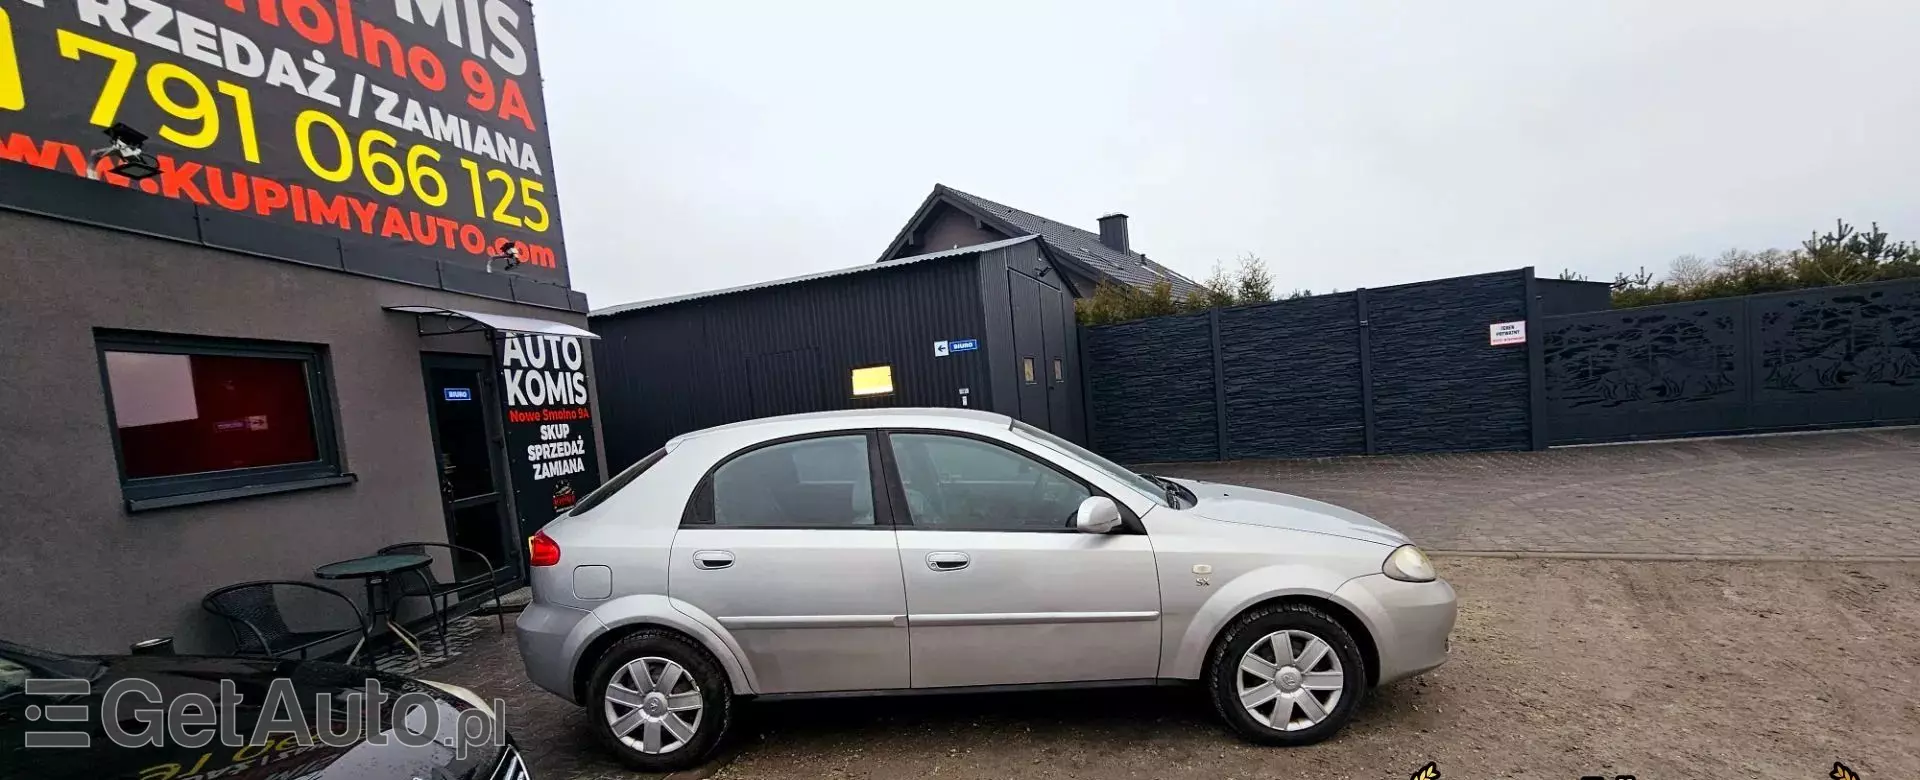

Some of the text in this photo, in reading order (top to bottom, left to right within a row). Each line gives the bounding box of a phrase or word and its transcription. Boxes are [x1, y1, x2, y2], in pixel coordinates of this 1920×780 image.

[24, 0, 341, 108] RZEDAŻ
[371, 83, 542, 176] ZAMIANA
[461, 59, 536, 132] 9A
[56, 28, 549, 232] 791 066 125
[503, 332, 582, 371] AUTO
[504, 369, 587, 406] KOMIS
[509, 410, 541, 423] Nowe
[542, 408, 577, 421] Smolno
[540, 424, 570, 440] SKUP
[527, 435, 586, 461] SPRZEDAŻ
[532, 457, 586, 480] ZAMIANA
[1195, 578, 1210, 587] SX
